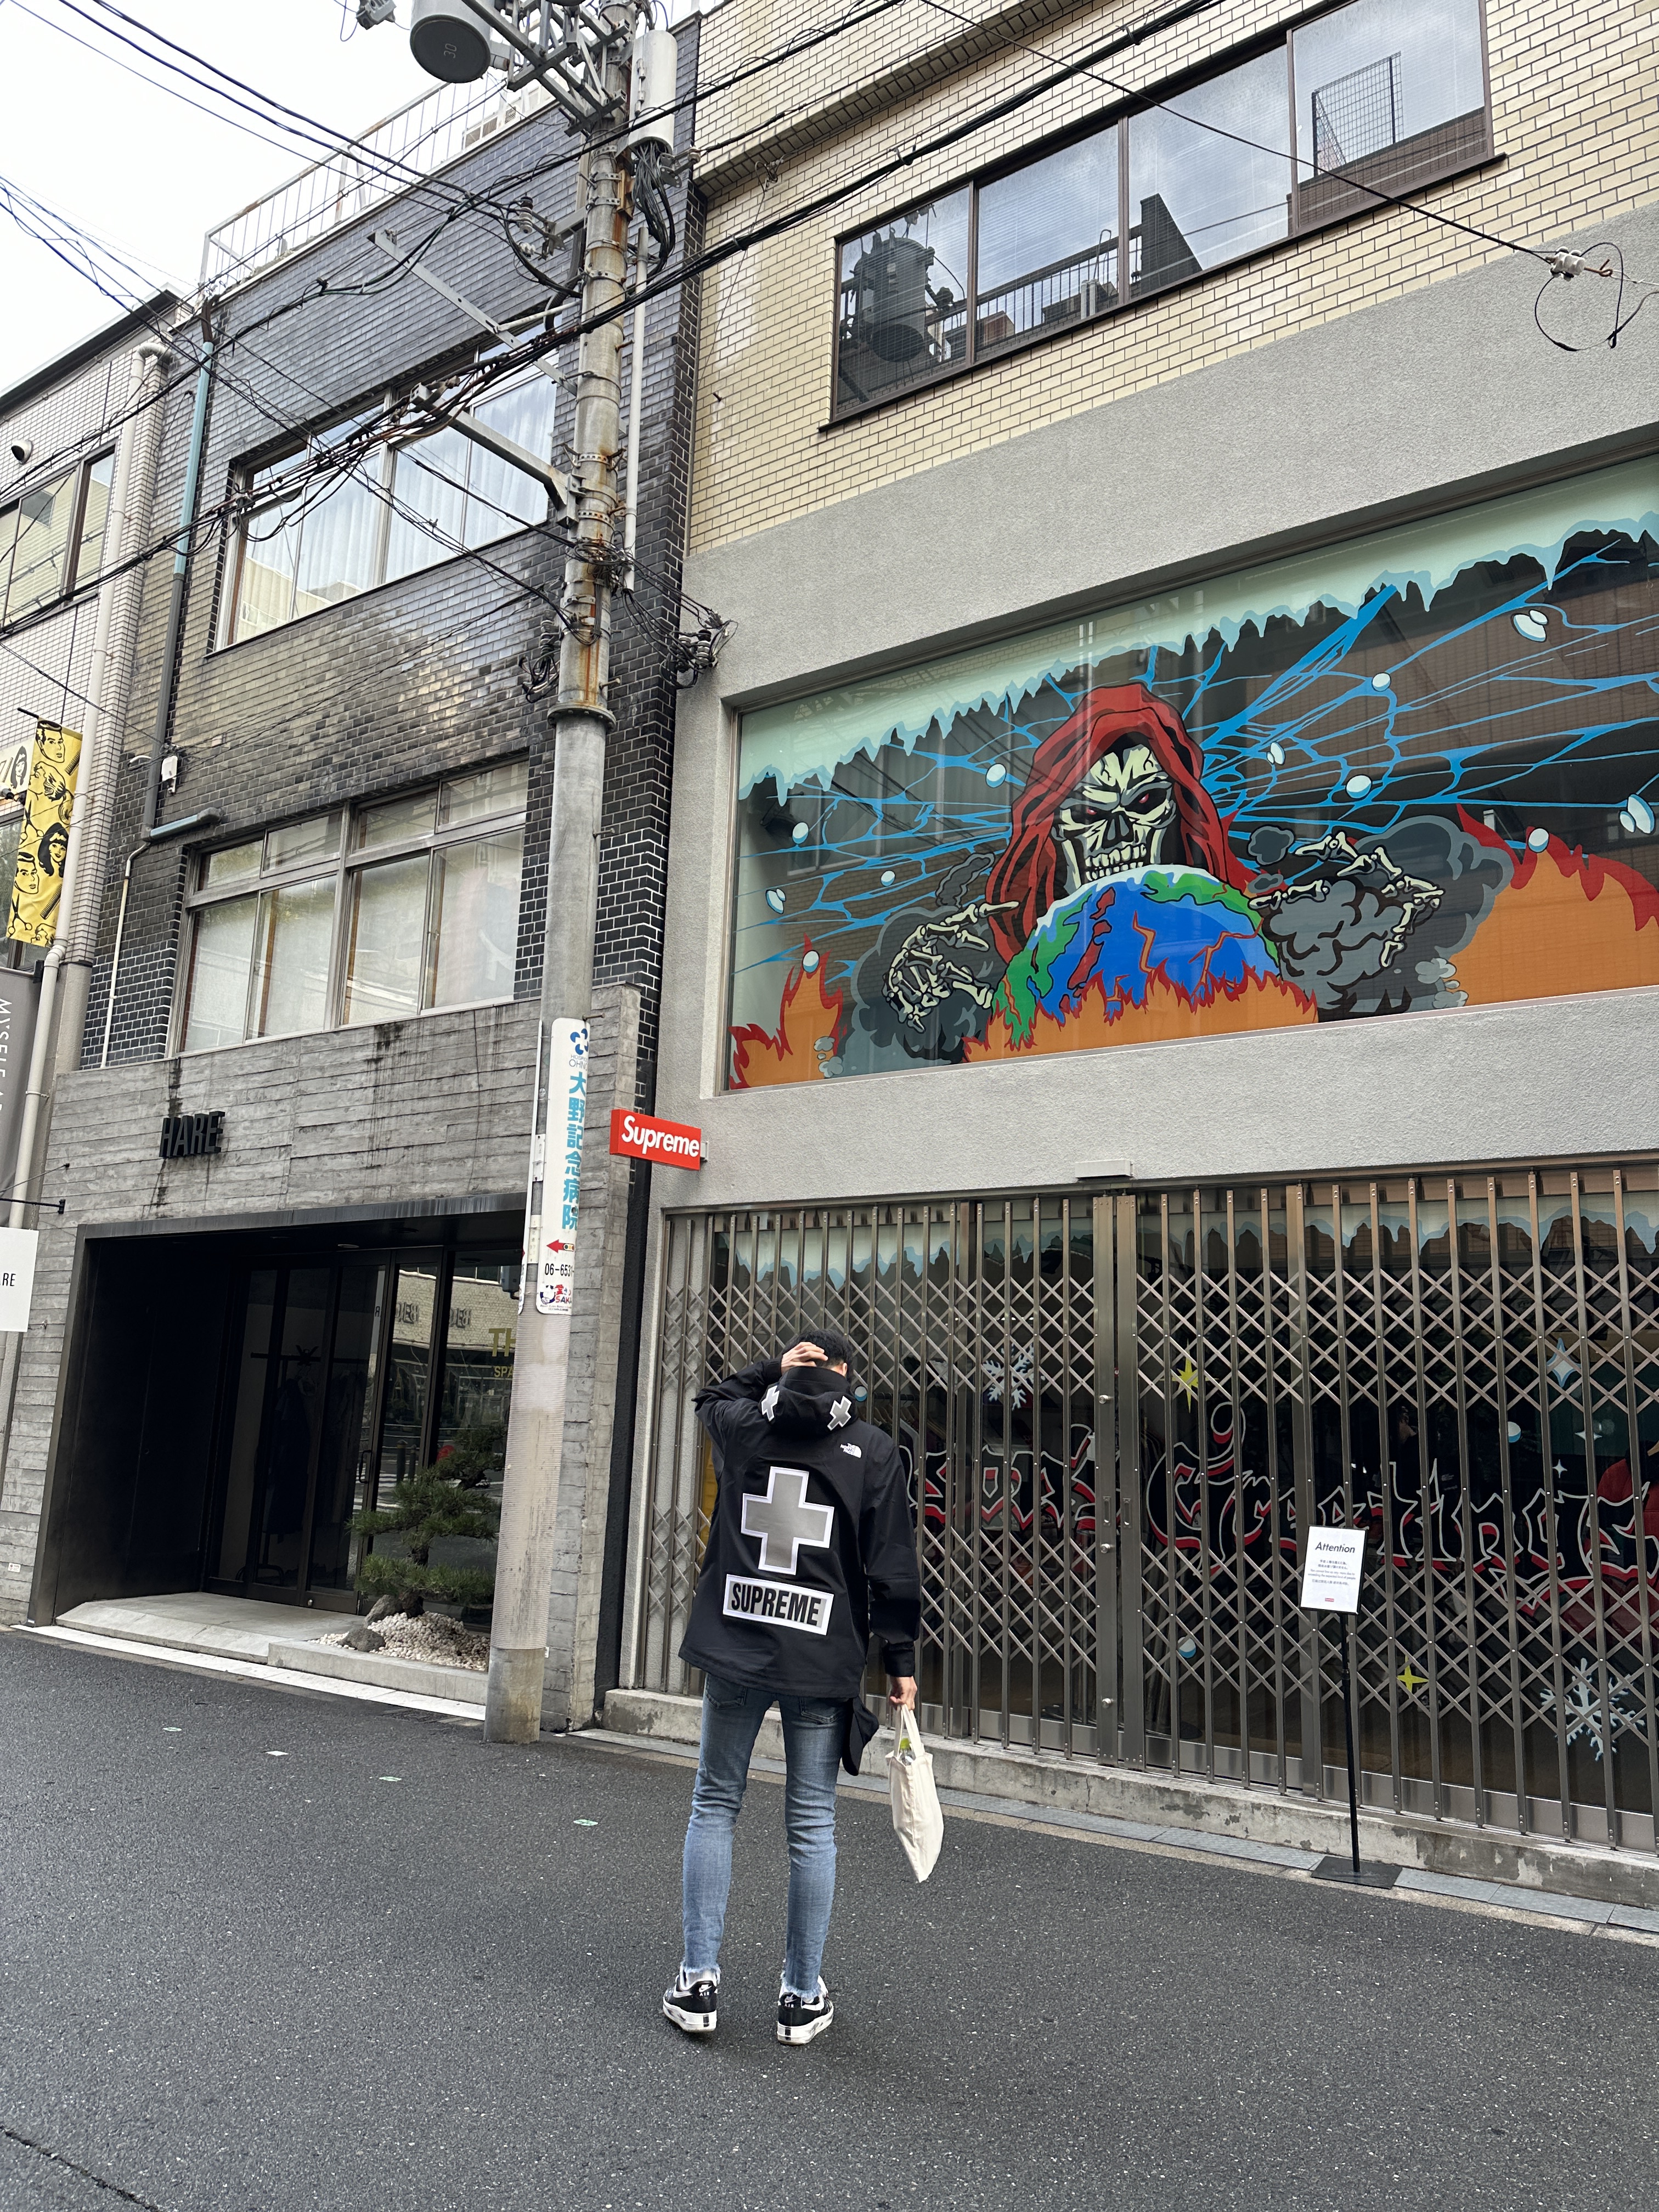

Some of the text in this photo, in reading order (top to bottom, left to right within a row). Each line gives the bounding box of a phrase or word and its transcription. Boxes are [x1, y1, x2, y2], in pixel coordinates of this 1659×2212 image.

[159, 1110, 225, 1158] HARE
[562, 1071, 586, 1231] 大野記念病院
[621, 1115, 700, 1158] Supreme
[1315, 1542, 1355, 1553] Attention
[731, 1583, 821, 1626] SUPREME
